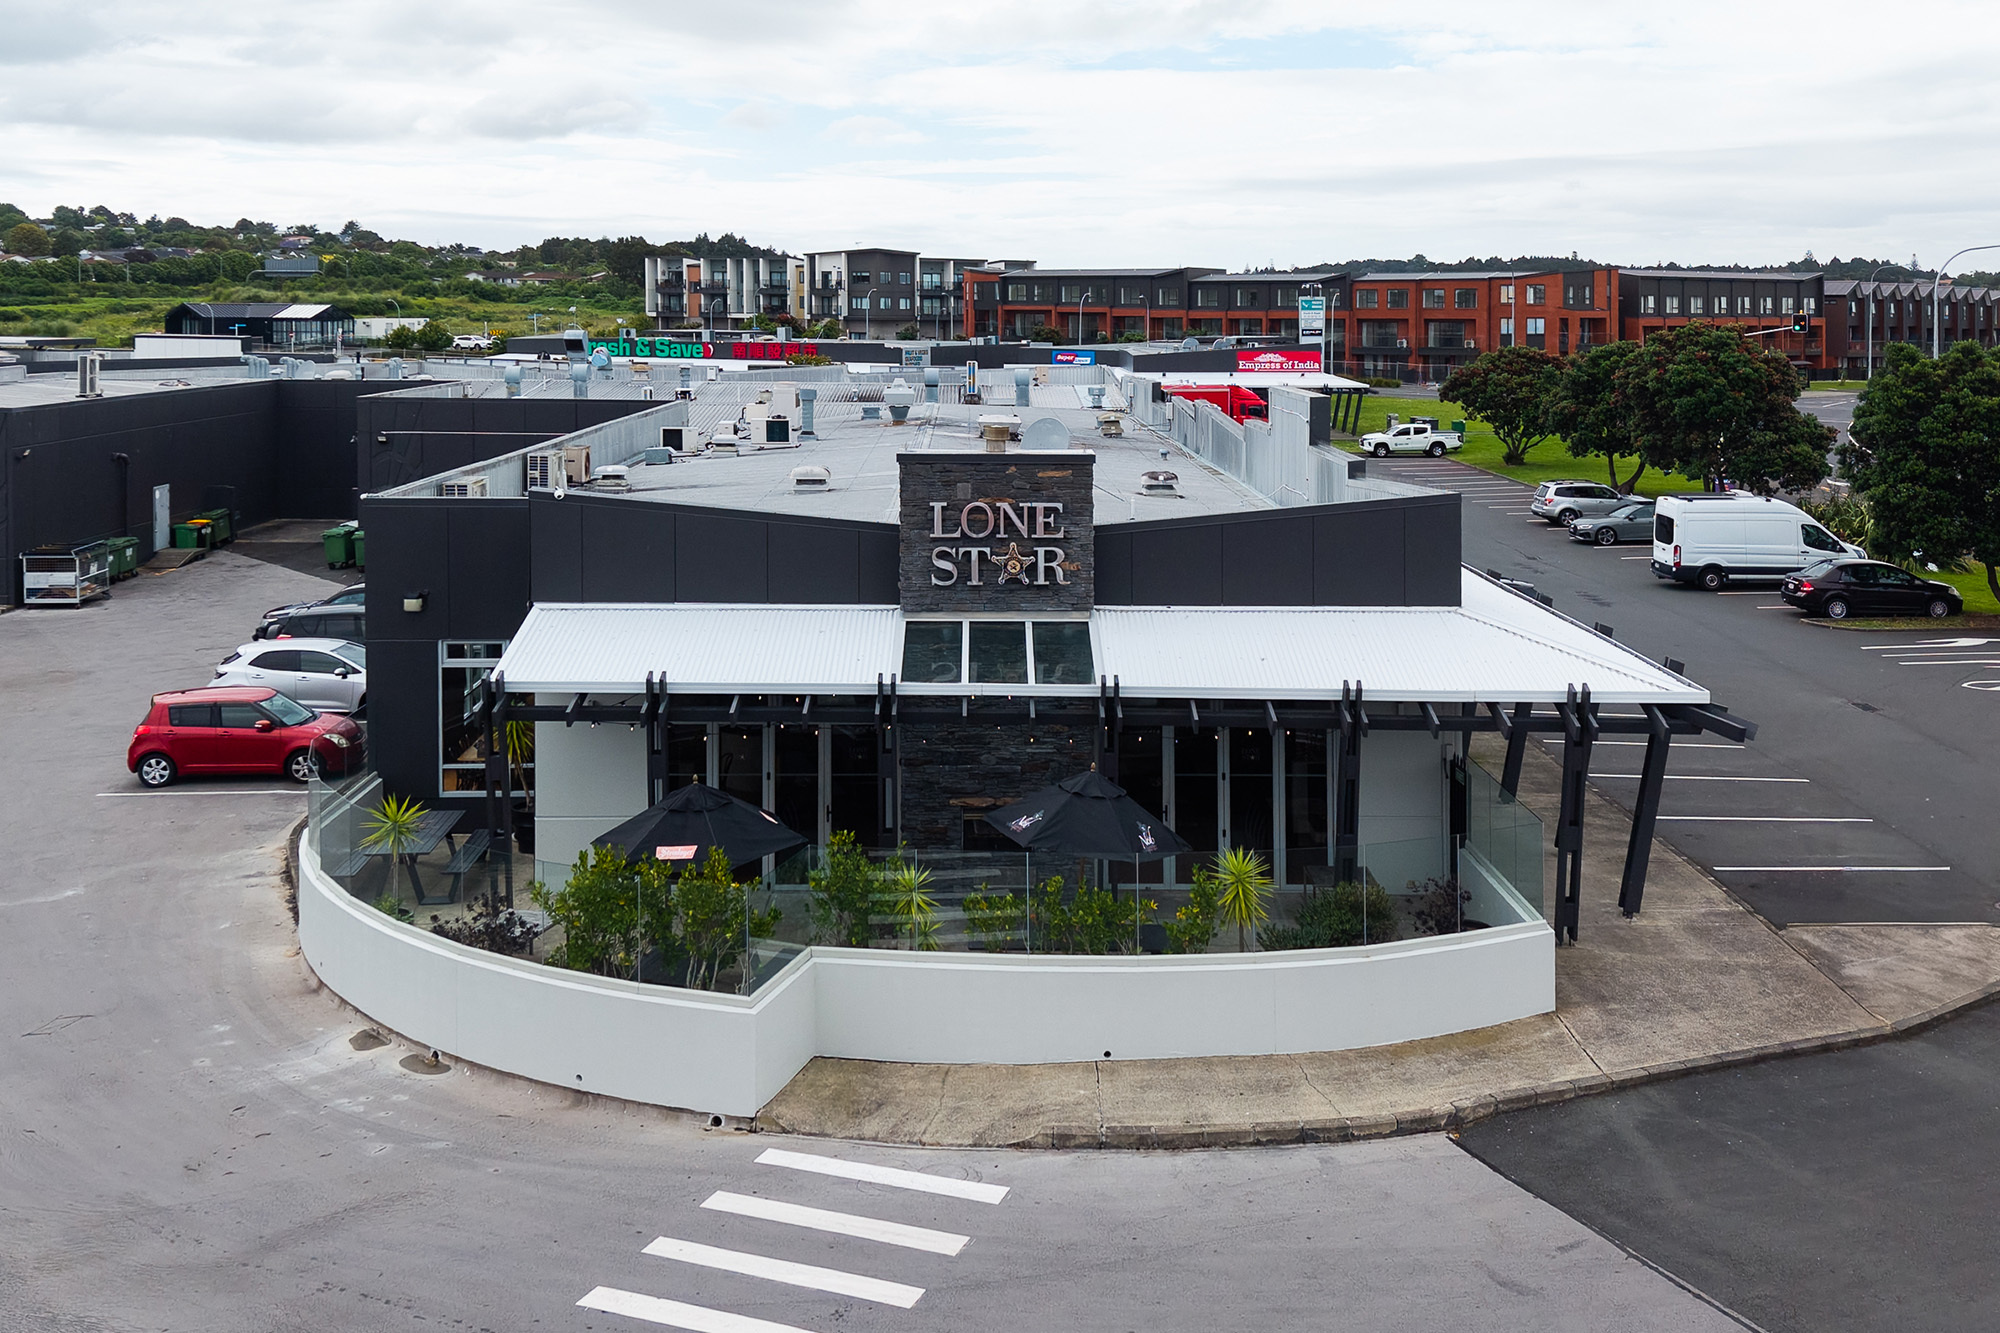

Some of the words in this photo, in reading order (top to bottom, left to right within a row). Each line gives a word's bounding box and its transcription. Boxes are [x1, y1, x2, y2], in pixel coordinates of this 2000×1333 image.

[588, 337, 630, 356] rsh
[636, 338, 651, 356] &
[655, 338, 704, 358] Save
[1238, 361, 1281, 371] Empress
[1282, 361, 1294, 369] of
[1294, 361, 1320, 369] India
[929, 501, 1065, 539] LONE
[931, 542, 1072, 586] STAR
